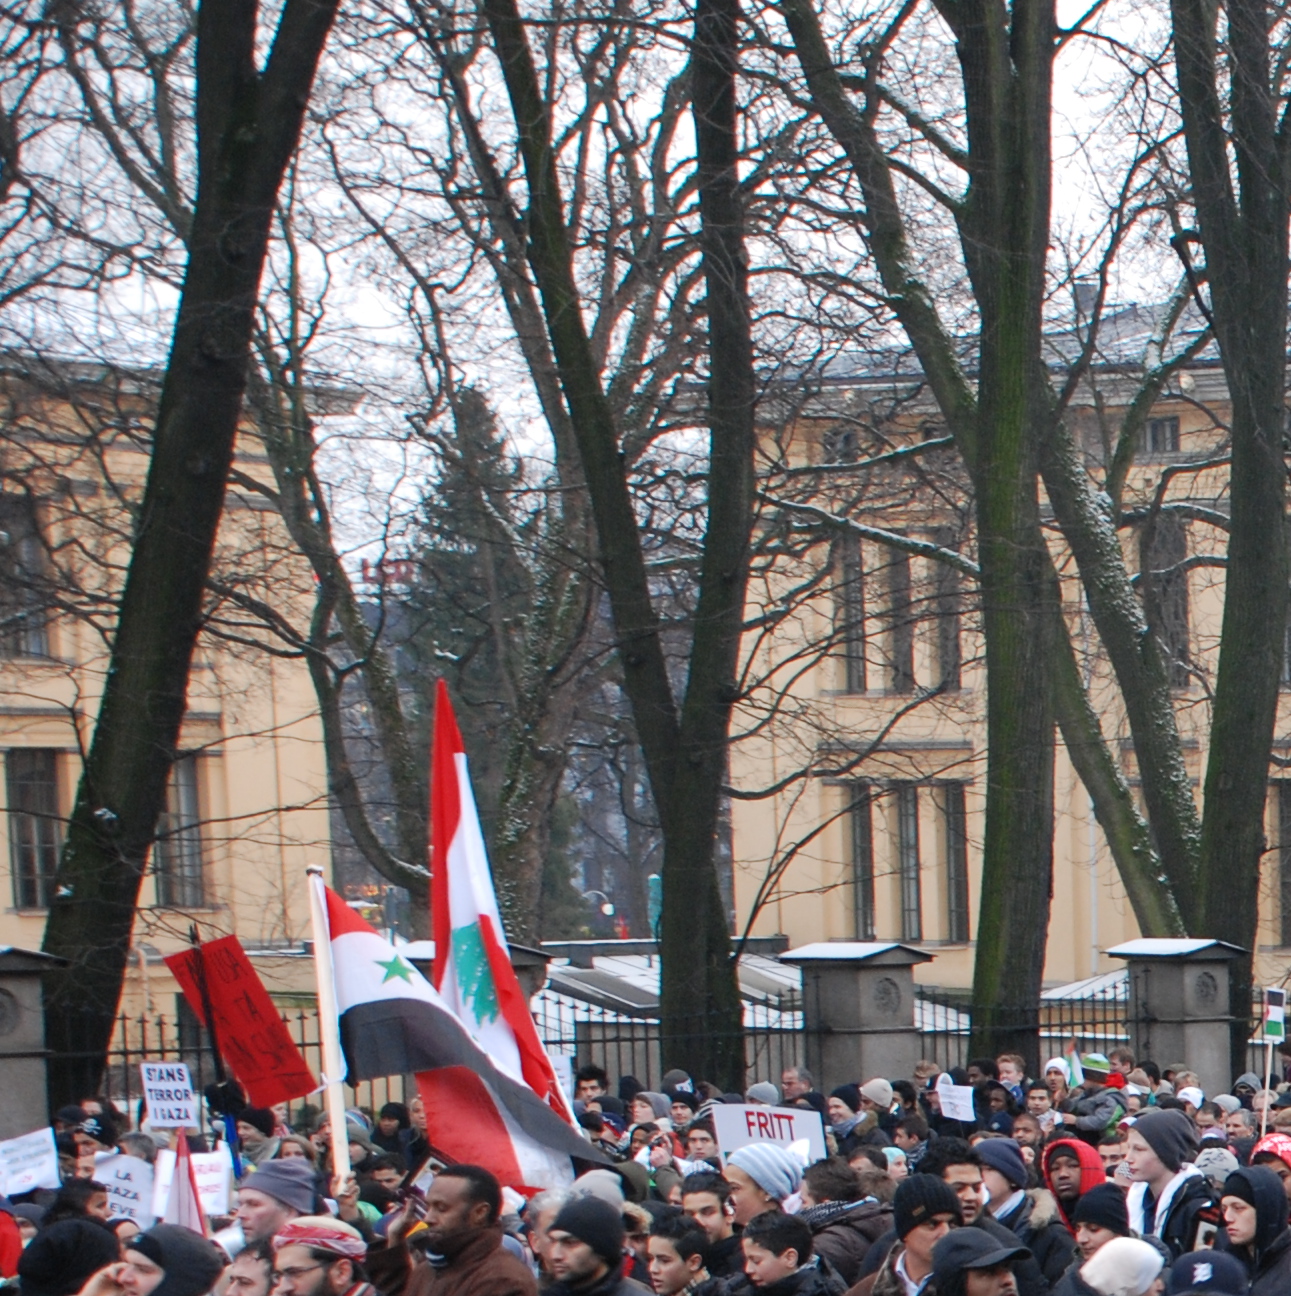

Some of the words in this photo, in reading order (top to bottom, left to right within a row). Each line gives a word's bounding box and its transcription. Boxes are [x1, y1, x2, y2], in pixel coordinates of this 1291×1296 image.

[146, 1067, 186, 1082] STANS
[148, 1088, 192, 1101] TERROR
[153, 1107, 159, 1119] I
[161, 1107, 191, 1120] GAZA
[744, 1110, 794, 1141] FRITT
[115, 1169, 133, 1182] LA
[108, 1202, 138, 1218] EVE
